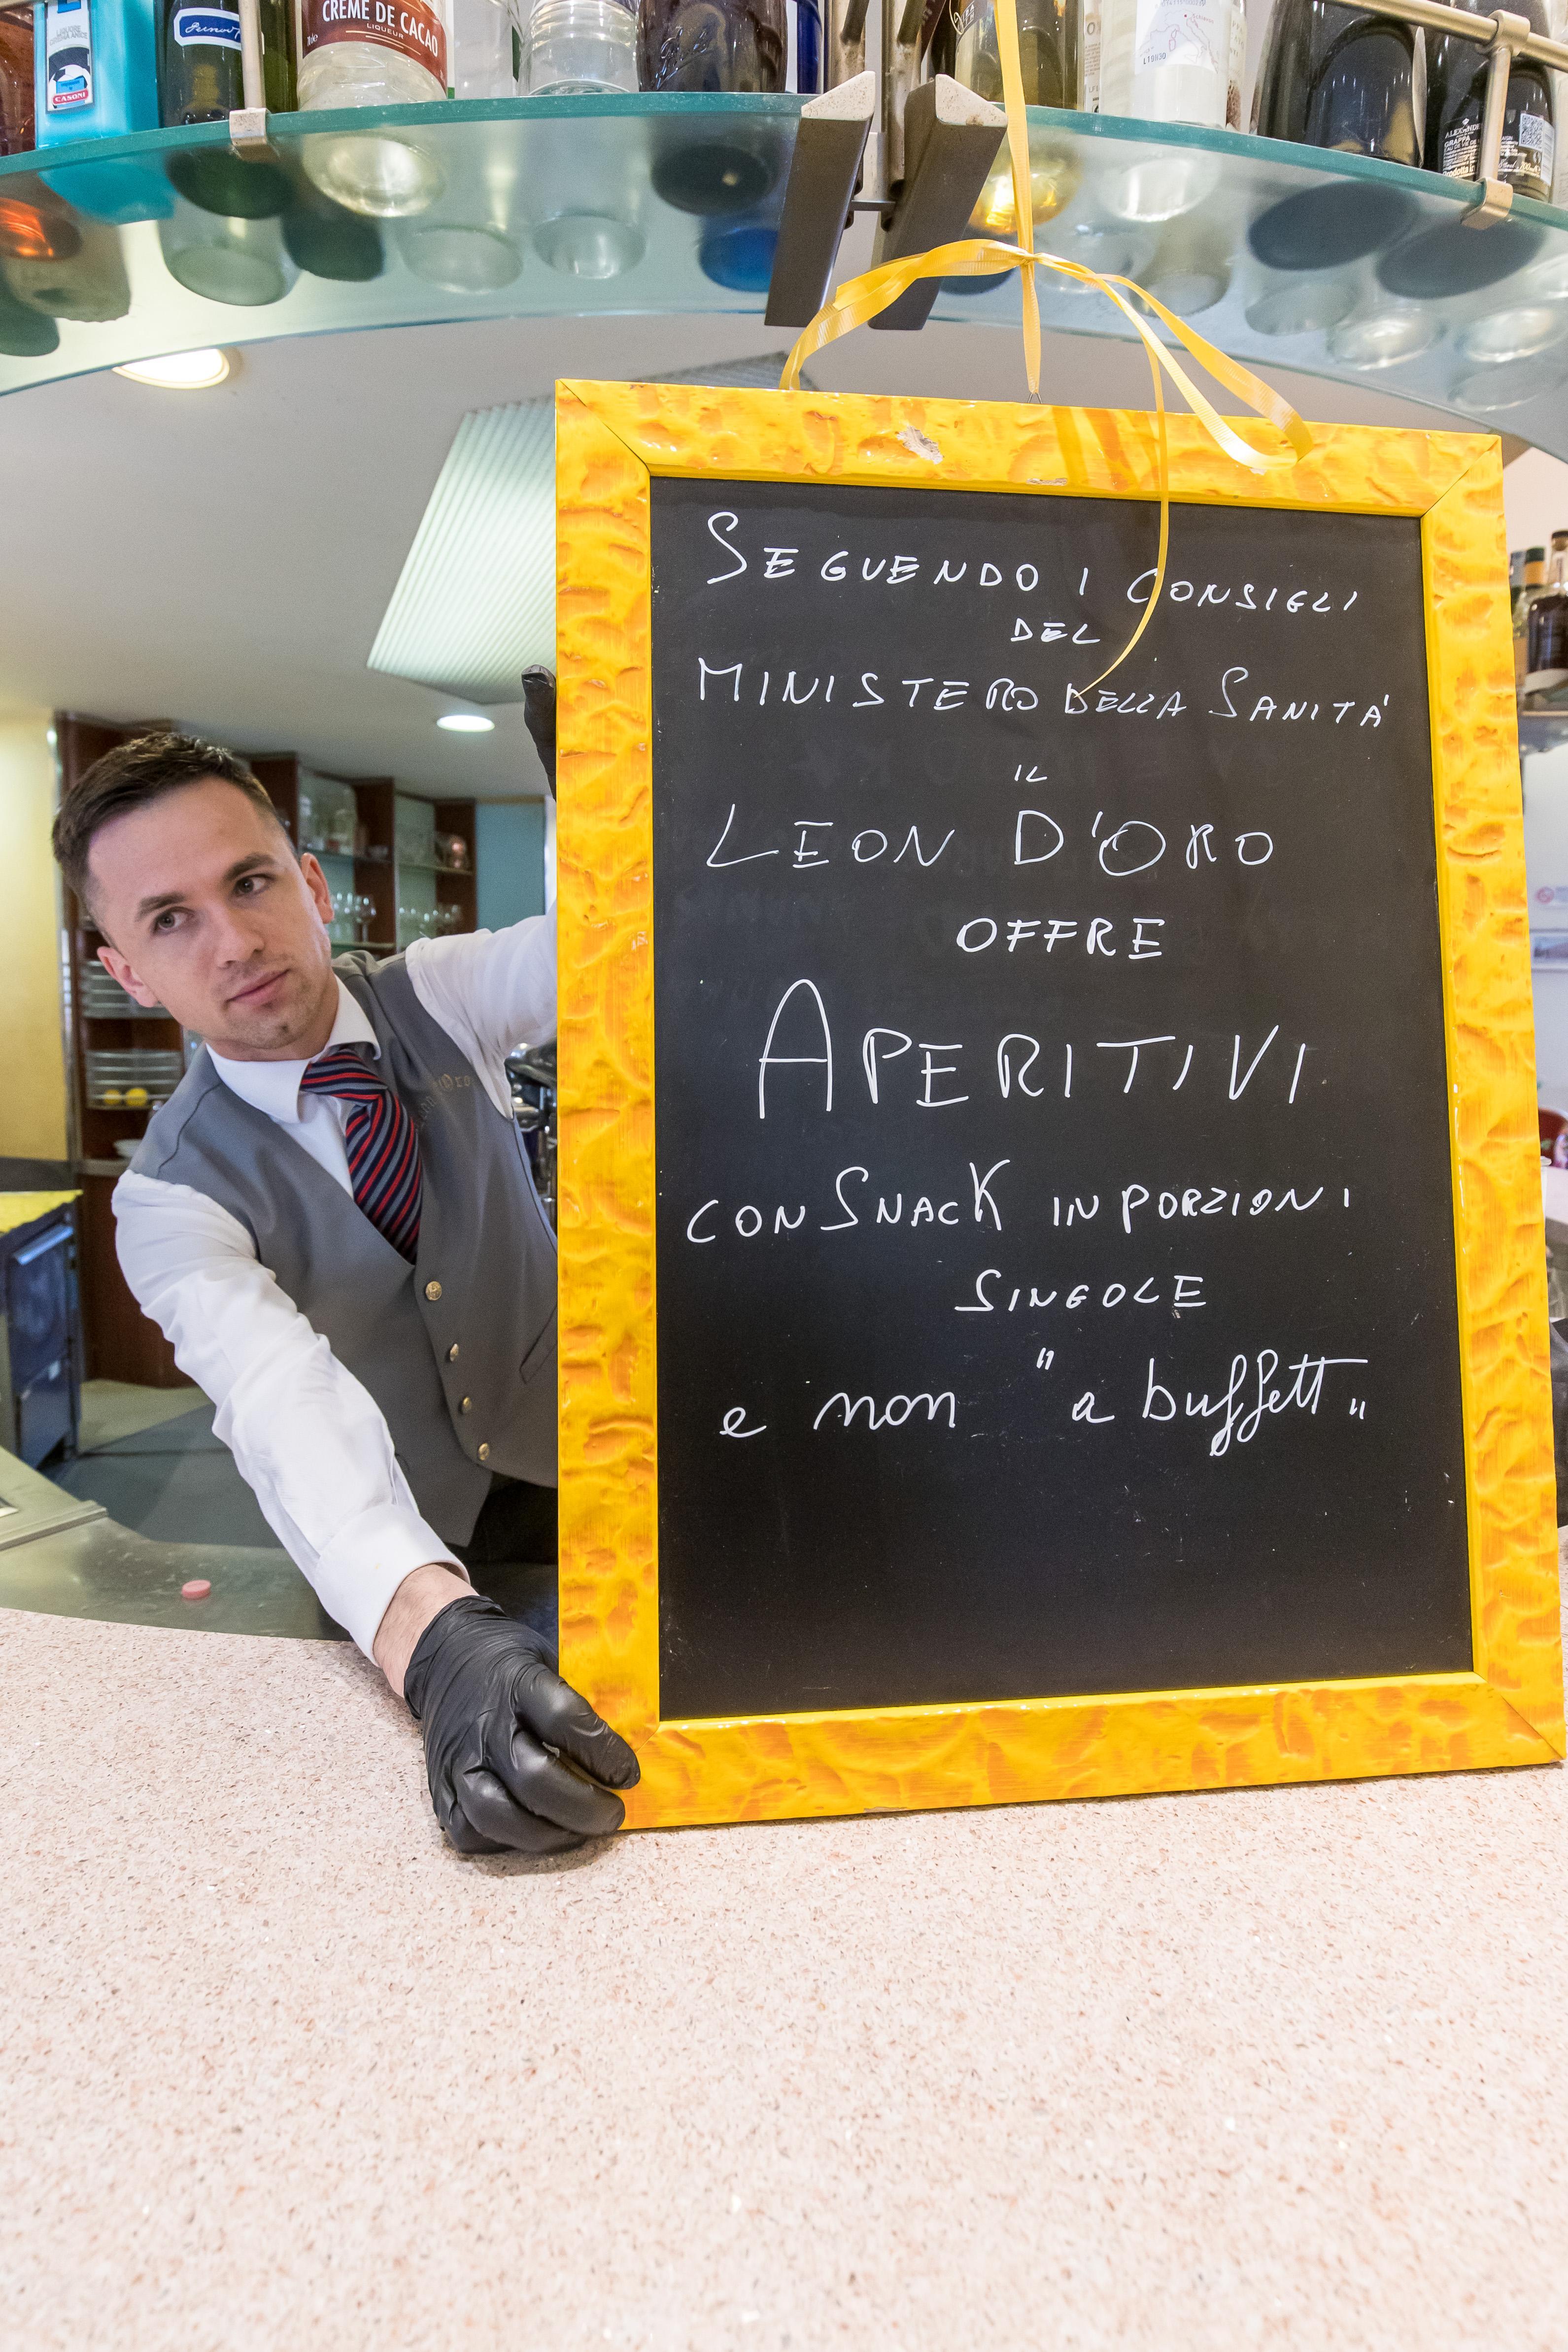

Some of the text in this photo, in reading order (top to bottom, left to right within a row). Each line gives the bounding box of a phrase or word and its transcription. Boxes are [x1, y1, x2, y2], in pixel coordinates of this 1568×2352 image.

[323, 0, 438, 58] CREME DE CACAO
[367, 23, 404, 39] LIQUEUR
[55, 92, 86, 102] CASONI
[1444, 135, 1470, 147] GRAPPA
[1445, 123, 1481, 138] ALEXANDE
[707, 511, 1358, 613] SEGUENDO I CONSIGLI
[1011, 618, 1102, 644] DEL
[698, 657, 1038, 711] MINISTERO
[1065, 683, 1187, 719] DELLA
[1015, 764, 1047, 782] IL
[707, 804, 1273, 876] LEON D'ORO
[956, 917, 1165, 959] OFFRE
[758, 979, 1309, 1119] APERITIVI
[687, 1200, 805, 1243] CON
[1053, 1195, 1099, 1227] IN
[1122, 1184, 1349, 1233] PORZIONI
[954, 1269, 1207, 1311] SINGOLE
[719, 1407, 767, 1437] e
